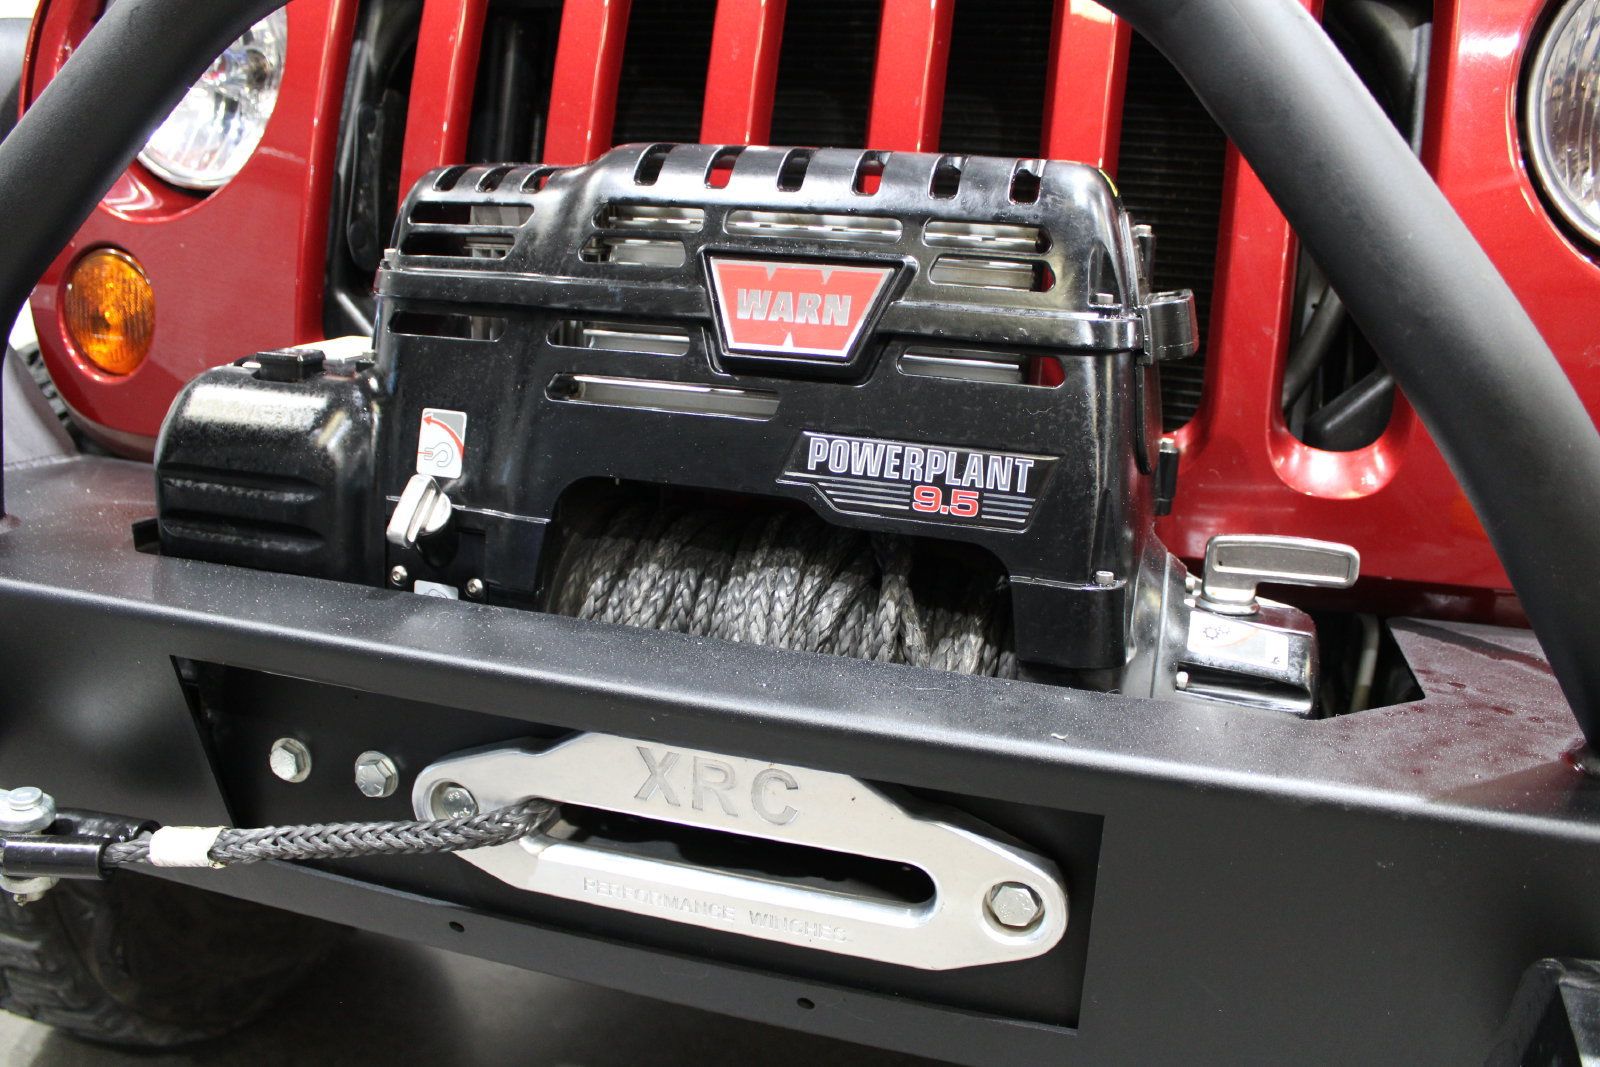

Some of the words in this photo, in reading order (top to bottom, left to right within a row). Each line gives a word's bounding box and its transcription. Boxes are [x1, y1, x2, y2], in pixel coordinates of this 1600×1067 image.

[737, 288, 851, 326] WARN
[807, 437, 1034, 493] POWERPLANT
[912, 485, 979, 517] 9.5
[634, 746, 799, 826] XRC
[583, 877, 735, 921] PERFORMANCE
[749, 910, 848, 943] WINCHES
